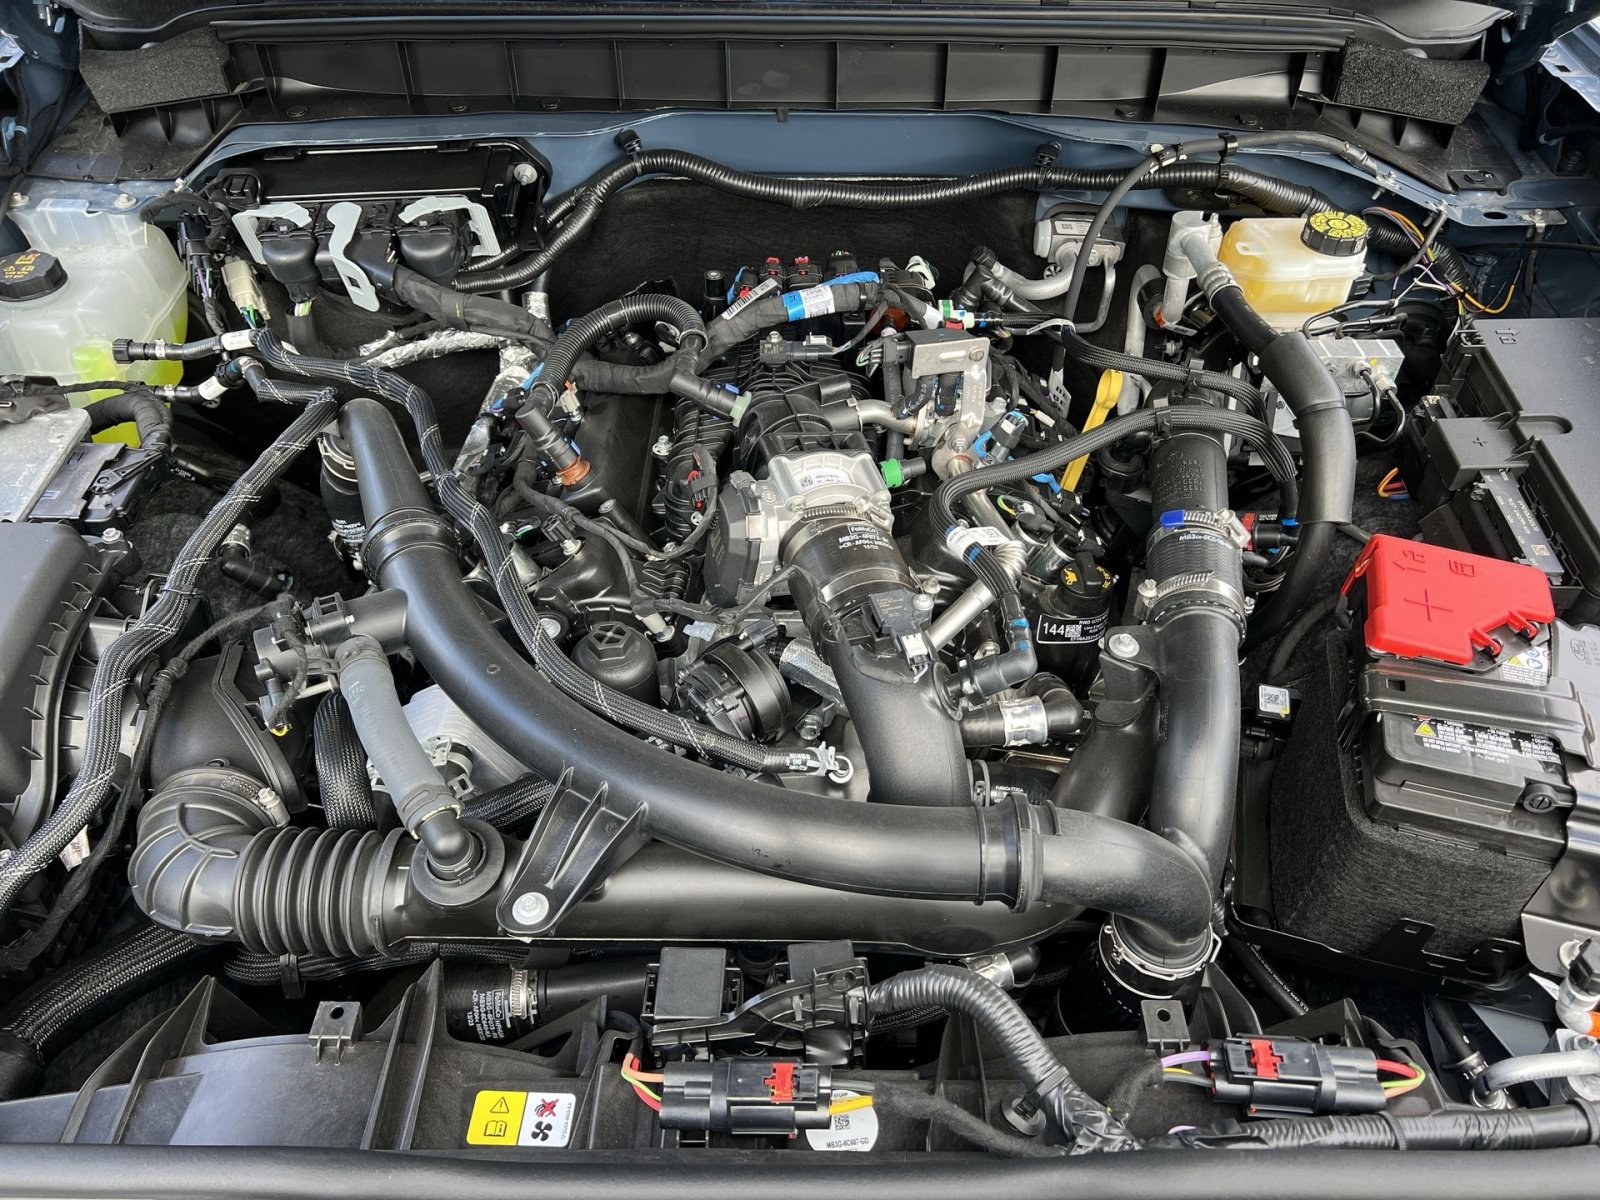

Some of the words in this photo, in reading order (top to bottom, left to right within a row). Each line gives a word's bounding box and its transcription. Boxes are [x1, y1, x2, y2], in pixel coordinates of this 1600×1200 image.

[850, 525, 877, 534] FoMoCo
[1042, 622, 1065, 636] 144
[494, 992, 502, 1018] FoMoCo
